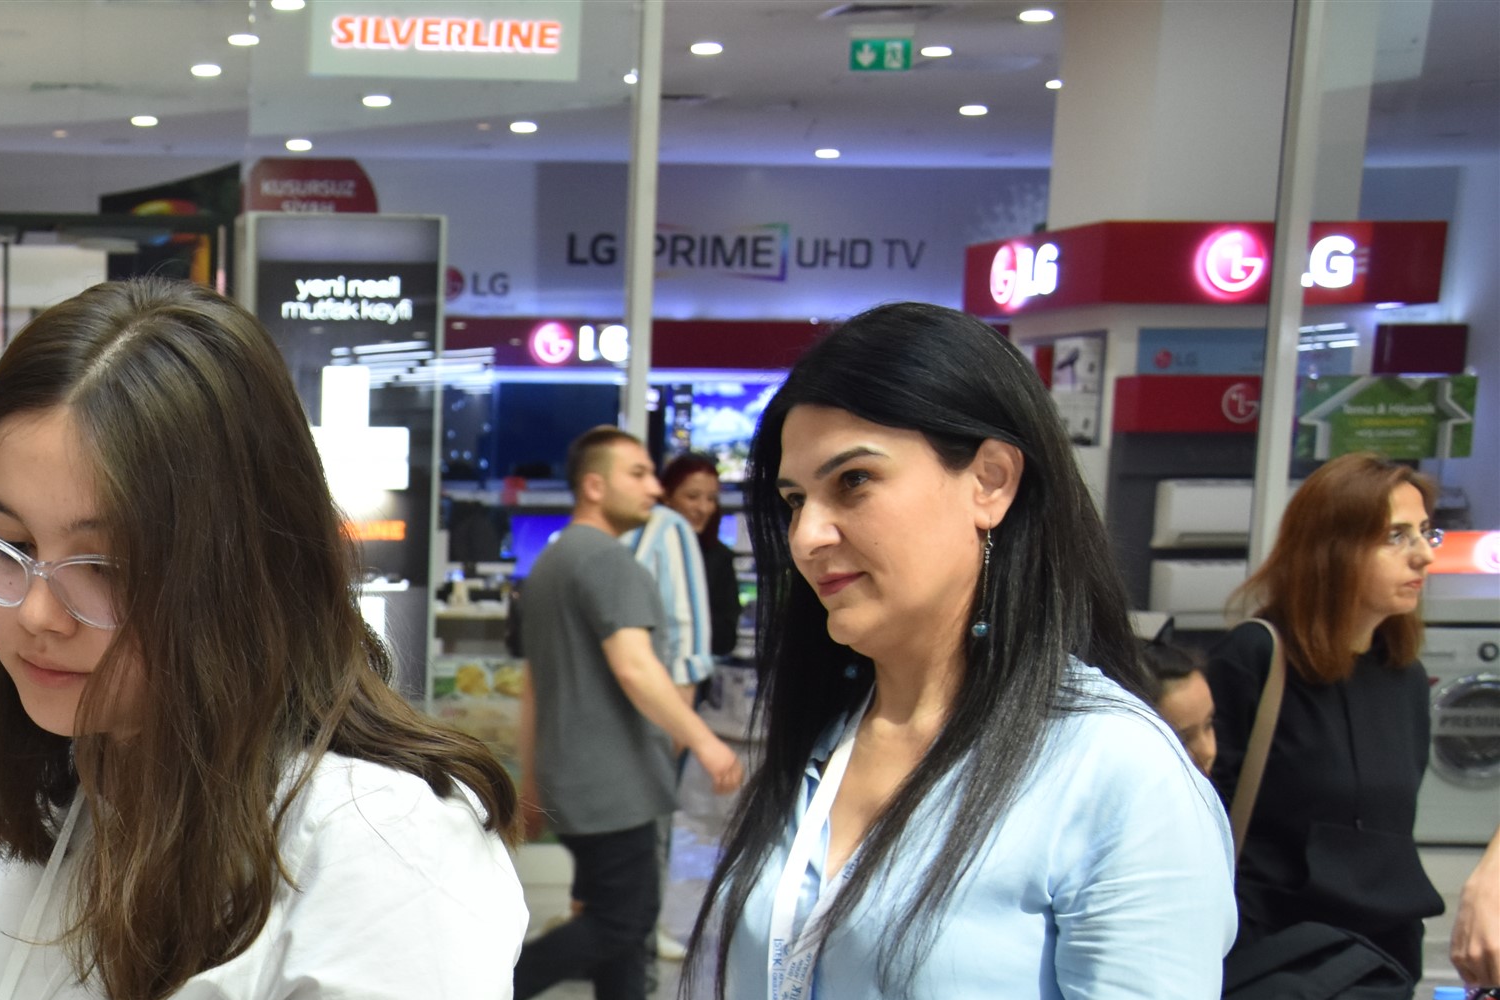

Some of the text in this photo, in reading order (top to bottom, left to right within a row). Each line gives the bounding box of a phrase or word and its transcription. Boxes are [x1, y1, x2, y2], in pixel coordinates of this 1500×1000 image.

[332, 16, 562, 54] SILVERLINE
[566, 233, 618, 266] LG
[796, 237, 873, 270] UHD
[882, 239, 927, 270] TV
[1300, 234, 1357, 289] G
[472, 272, 510, 296] LG
[578, 324, 630, 363] LG
